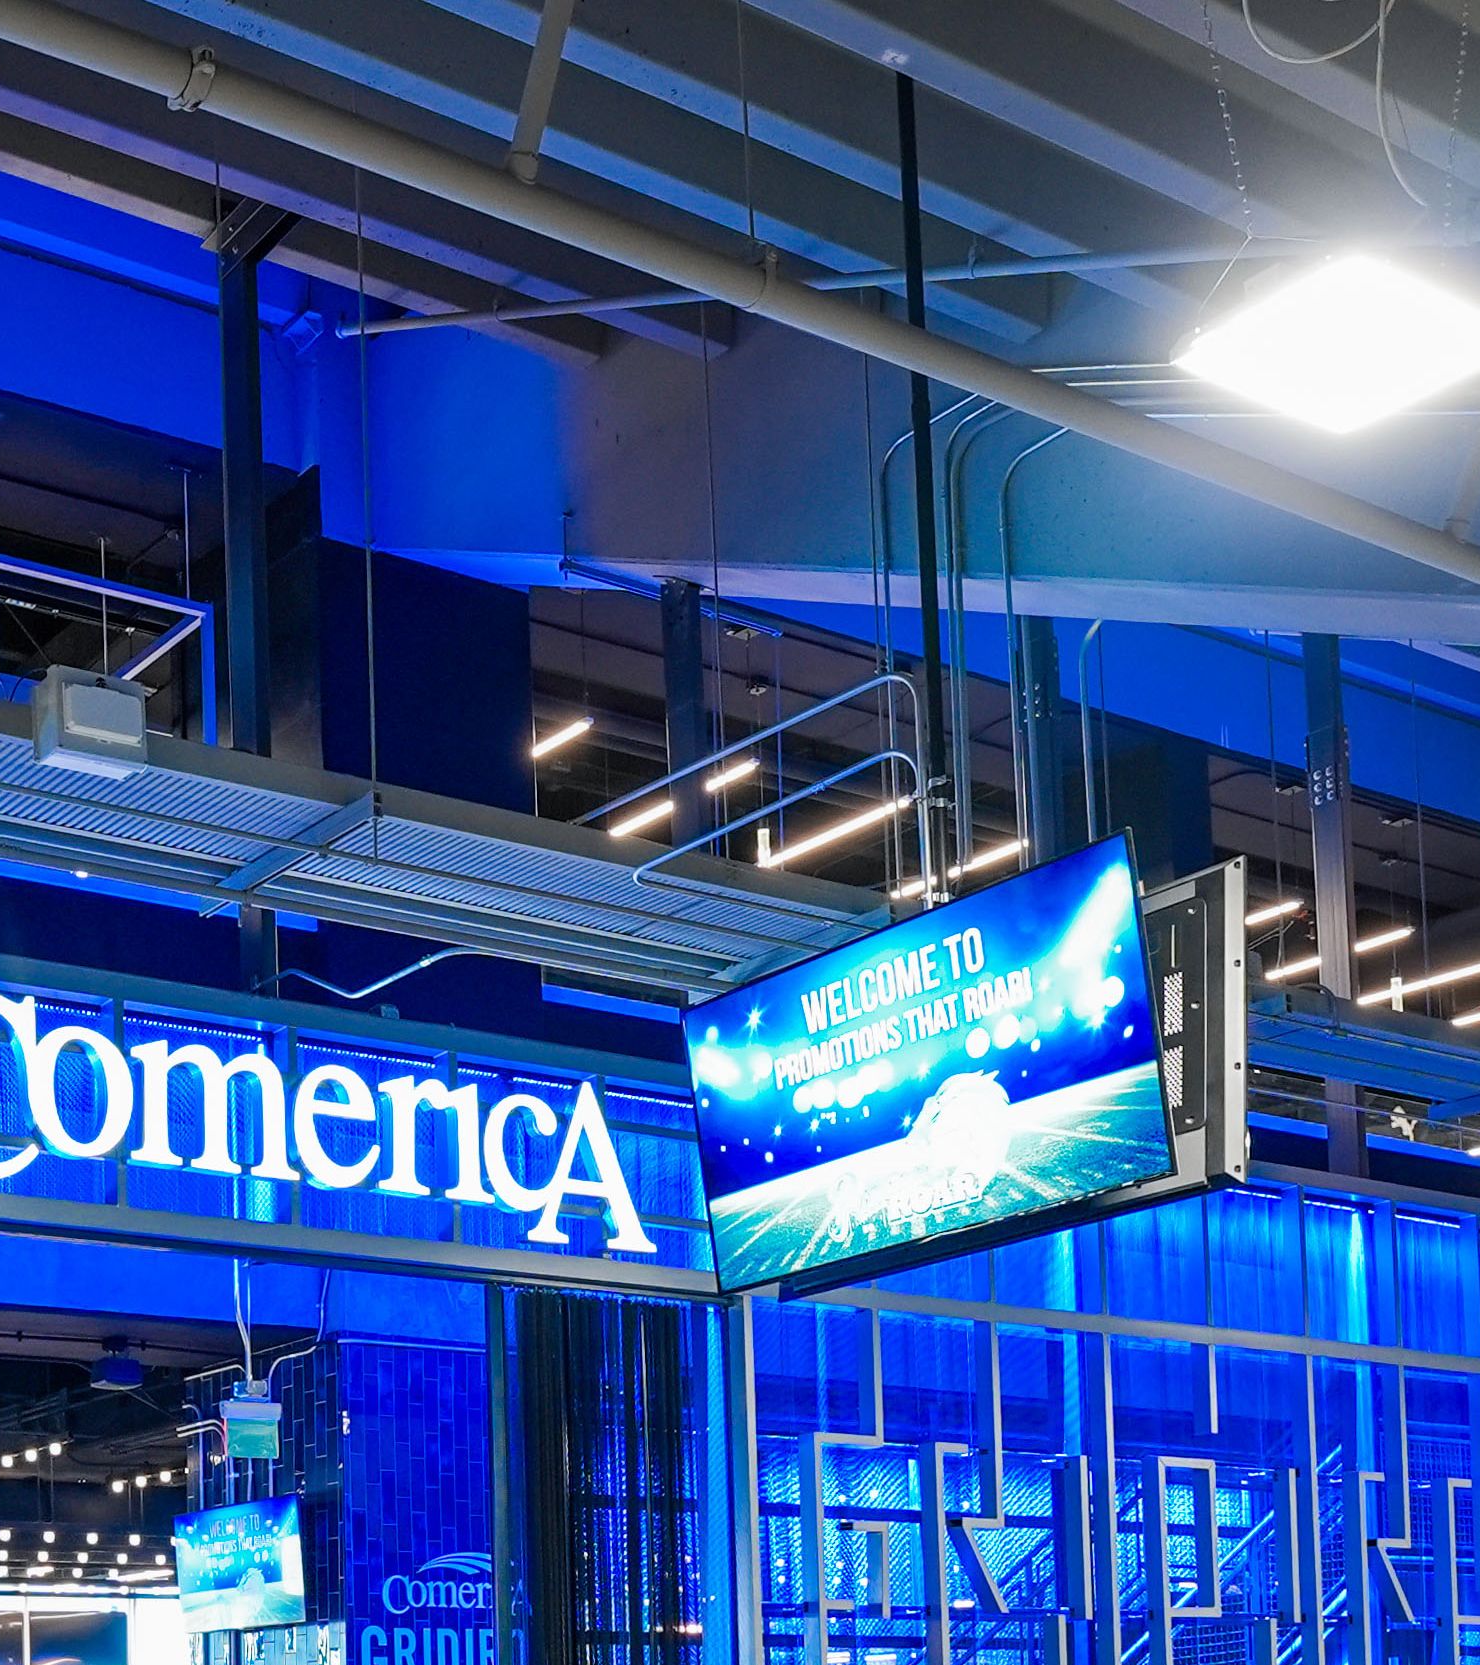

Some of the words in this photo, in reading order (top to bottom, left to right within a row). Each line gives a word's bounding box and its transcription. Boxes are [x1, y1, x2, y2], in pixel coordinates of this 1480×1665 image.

[800, 943, 941, 1035] WELCOME
[942, 927, 986, 981] TO
[773, 1012, 904, 1092] PROMOTIONS
[902, 992, 960, 1044] THAT
